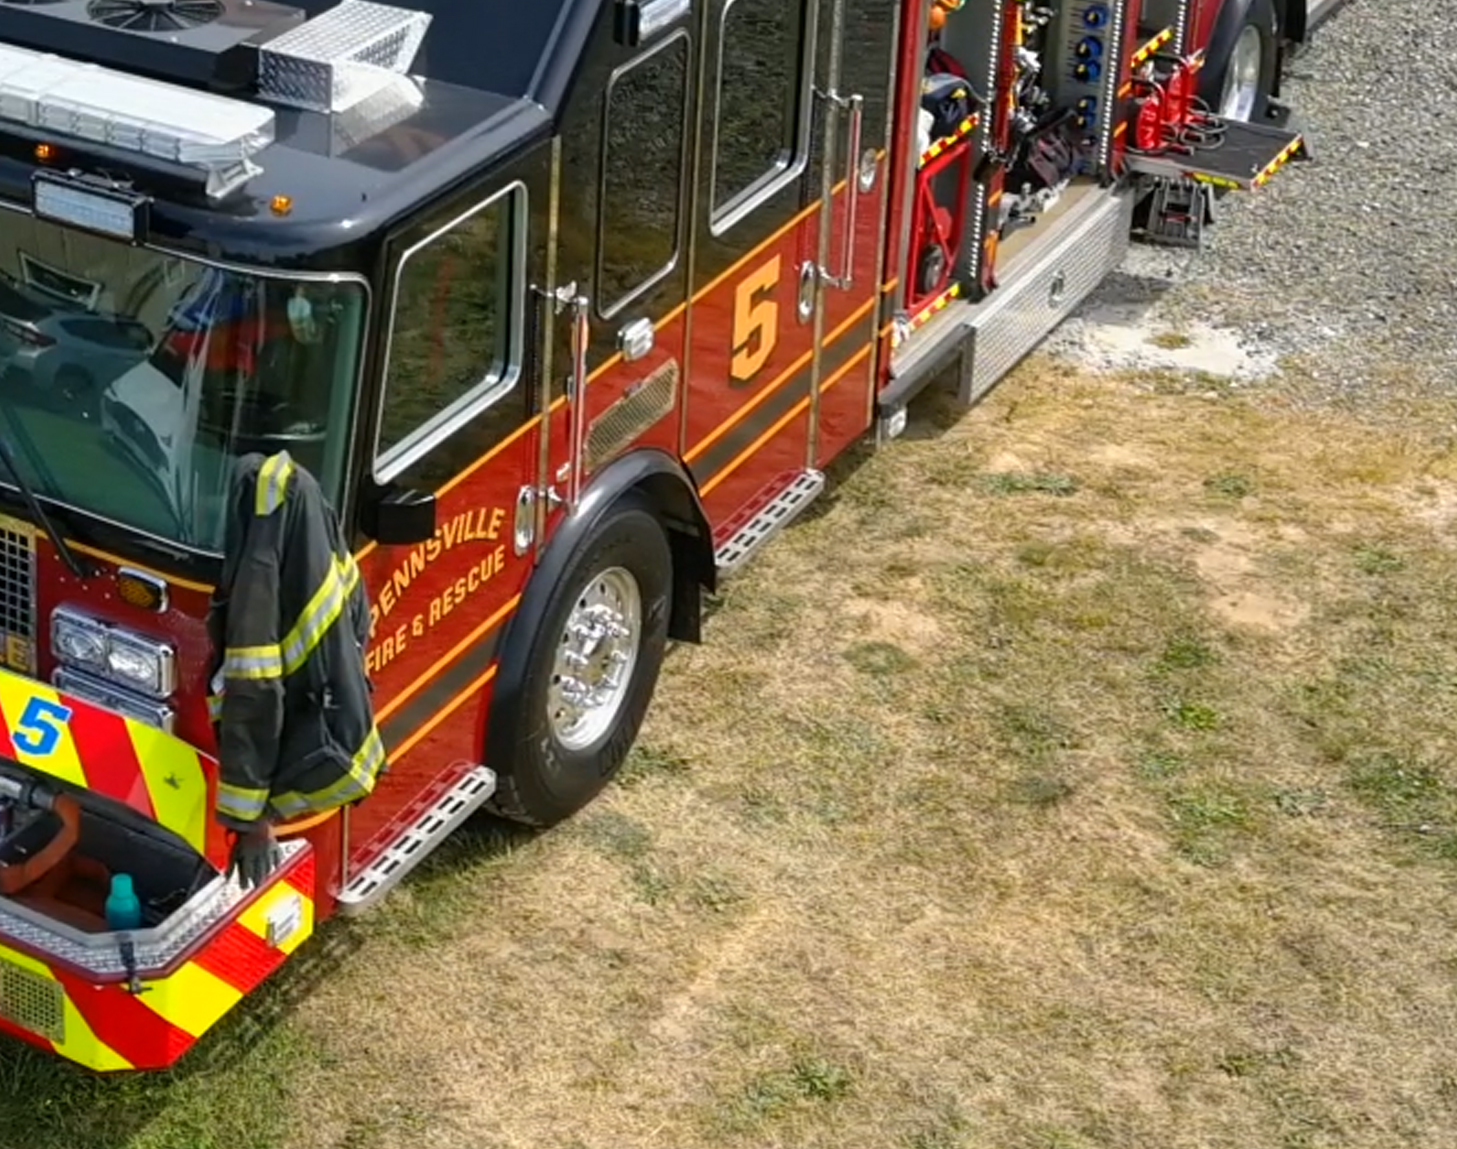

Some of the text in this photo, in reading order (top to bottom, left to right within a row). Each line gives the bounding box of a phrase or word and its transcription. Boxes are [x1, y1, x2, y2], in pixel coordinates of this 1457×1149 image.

[730, 253, 782, 382] 5
[363, 623, 407, 678] FIRE
[428, 544, 506, 627] RESCUE
[368, 507, 506, 639] PENNSVILLE
[10, 695, 73, 756] 5
